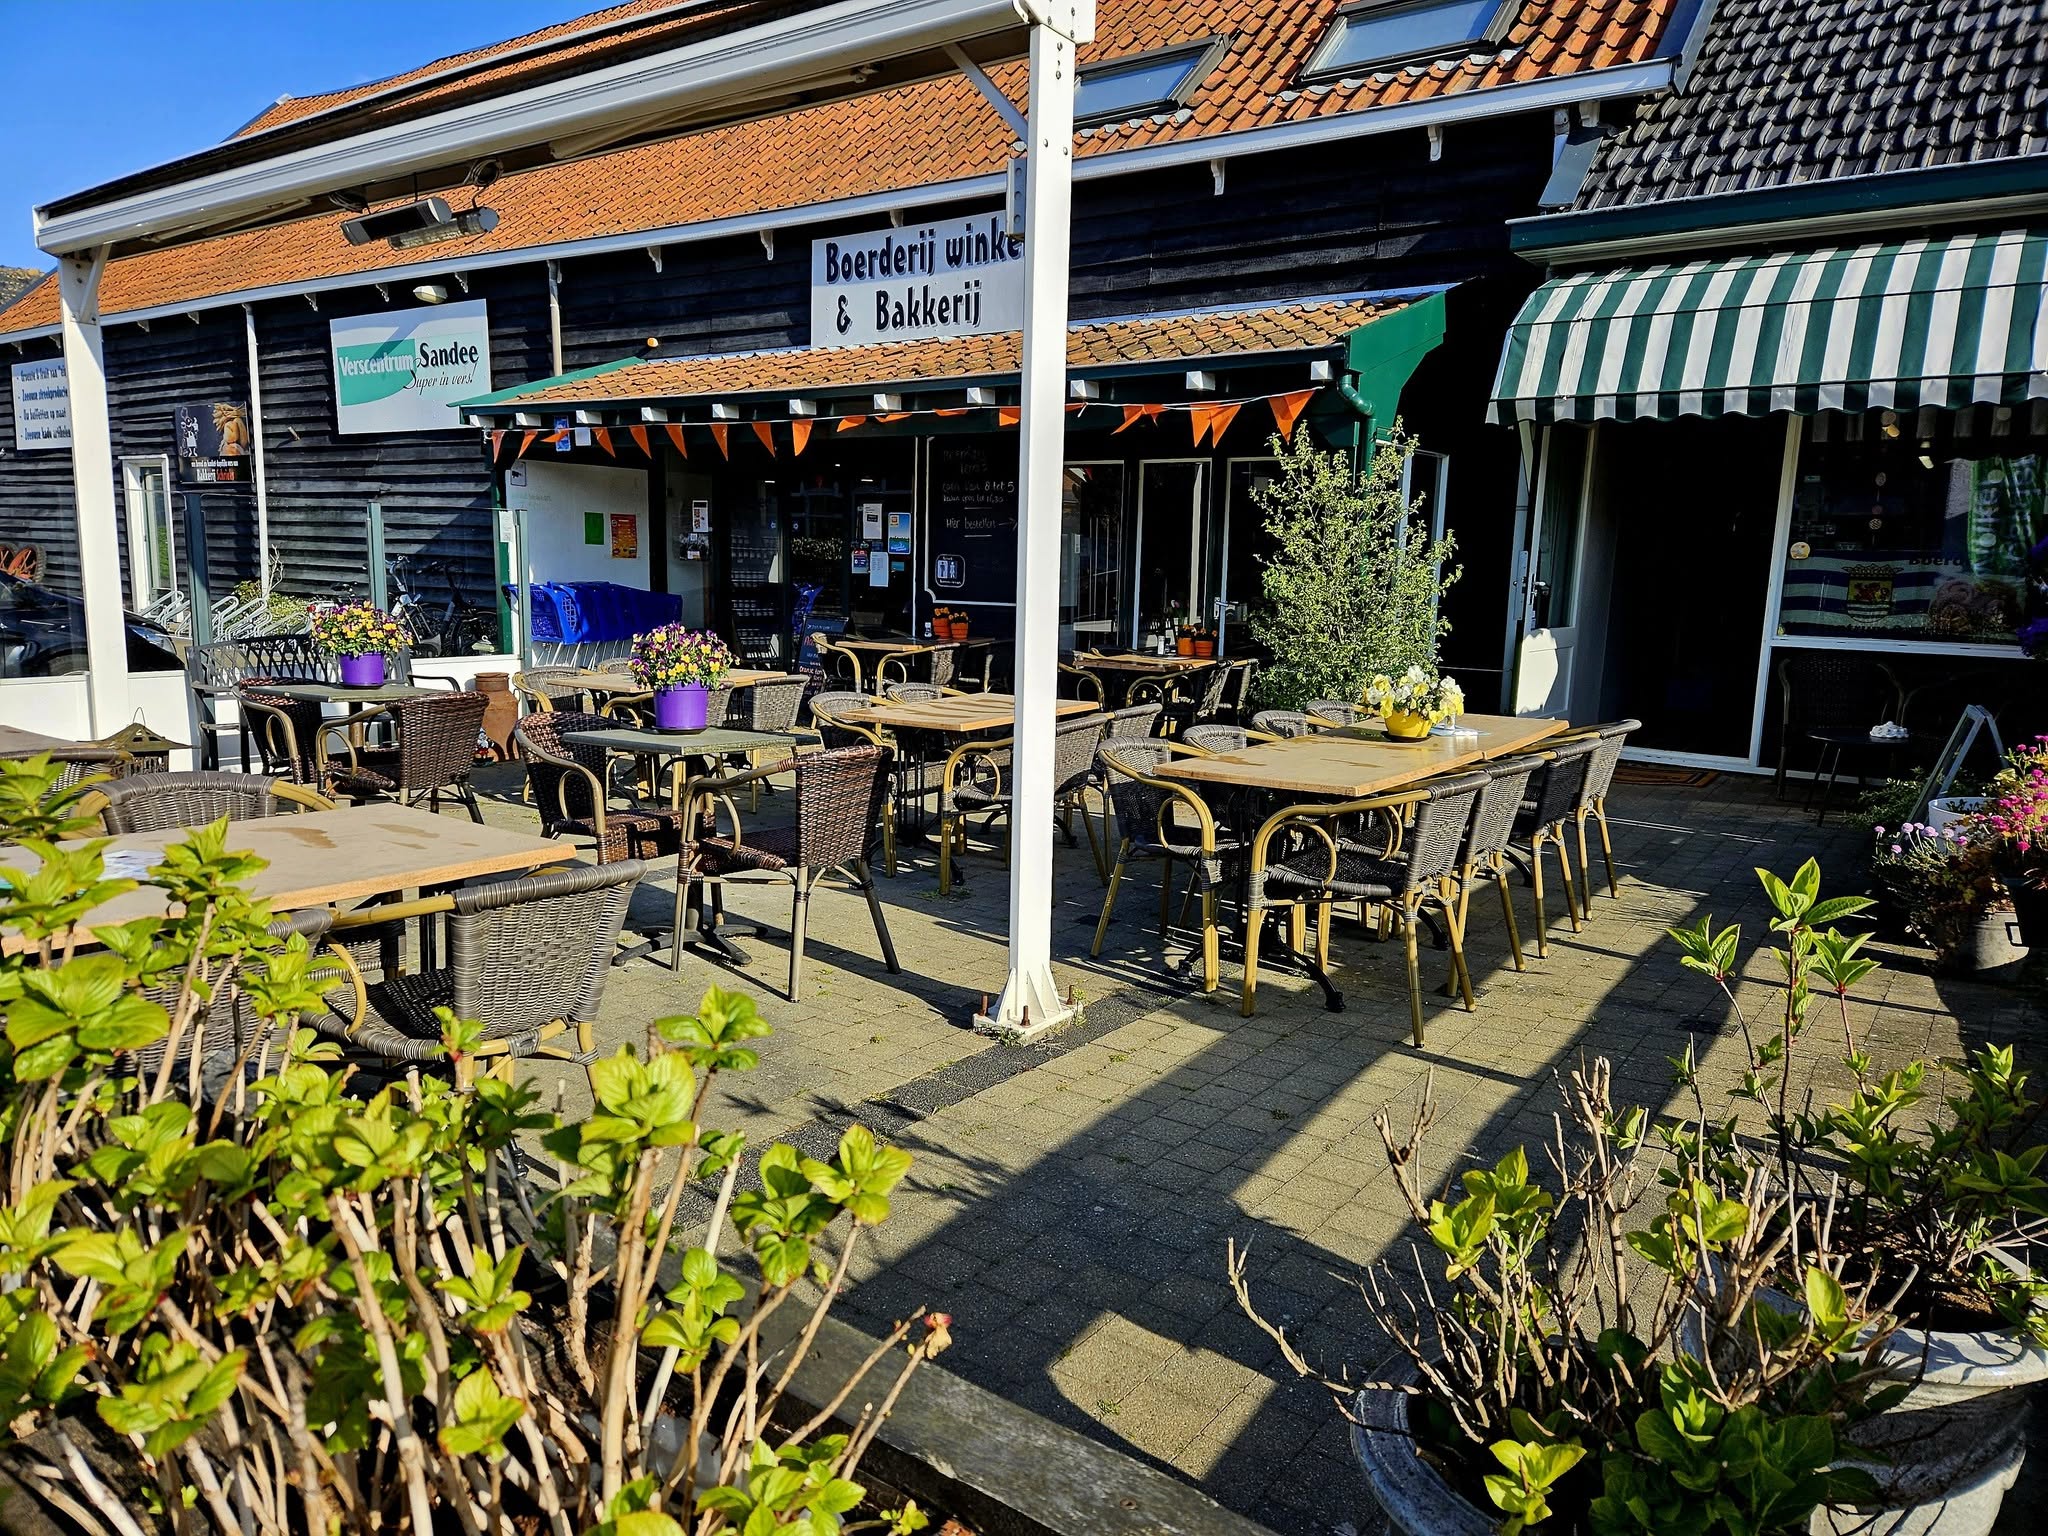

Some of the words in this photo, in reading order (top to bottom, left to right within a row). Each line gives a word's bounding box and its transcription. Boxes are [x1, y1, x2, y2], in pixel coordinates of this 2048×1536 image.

[826, 228, 936, 284] Boerderij
[946, 216, 1024, 268] winke
[836, 294, 852, 335] &
[876, 279, 982, 332] Bakkerij
[339, 352, 414, 377] Verscentrum
[416, 341, 480, 369] Sandee
[403, 369, 438, 395] Super
[439, 371, 449, 386] in
[451, 362, 478, 384] vers!
[196, 468, 217, 482] Bakkerij
[984, 480, 990, 491] 8
[993, 480, 1005, 490] tot
[1007, 481, 1015, 493] 5
[946, 517, 960, 529] Hier
[964, 516, 997, 529] bestellen
